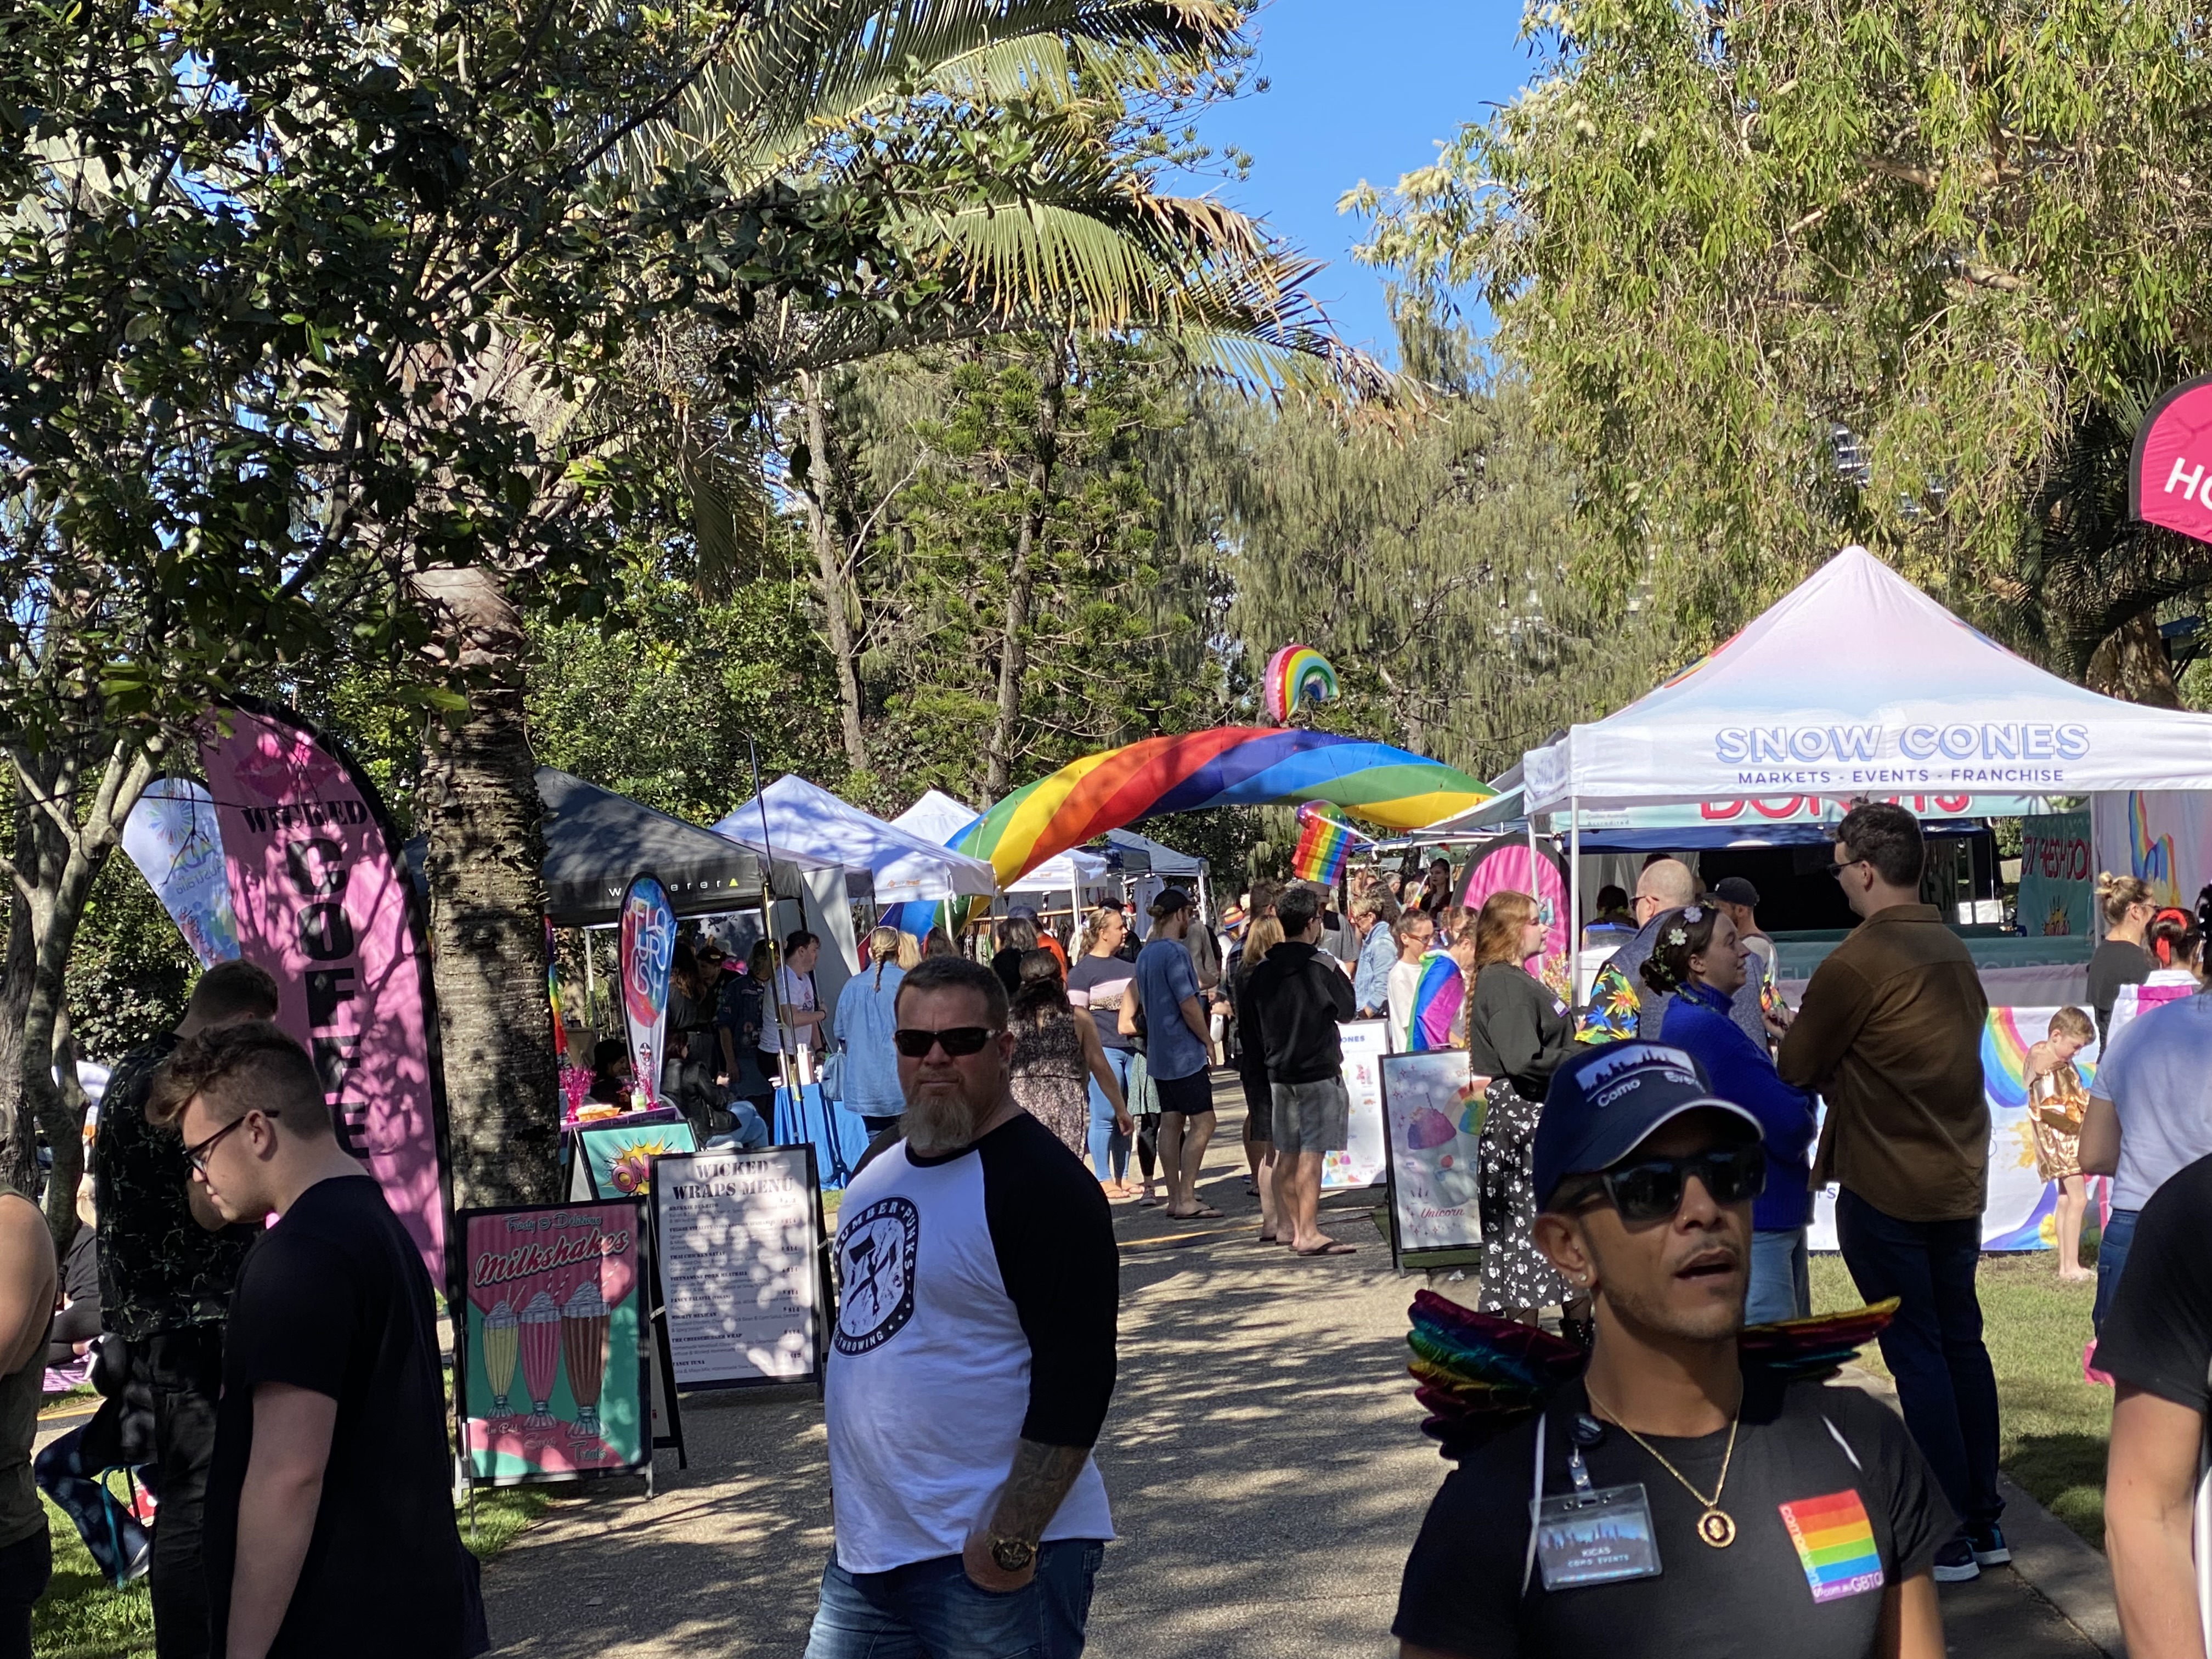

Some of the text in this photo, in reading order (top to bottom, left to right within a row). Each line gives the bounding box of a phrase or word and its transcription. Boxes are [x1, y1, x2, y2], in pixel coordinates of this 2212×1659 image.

[1716, 724, 2090, 763] SNOW CONES
[1739, 771, 1830, 783] MARKETS
[1853, 770, 1929, 782] EVENTS
[1951, 769, 2064, 782] FRANCHISE
[241, 800, 368, 833] WICKED
[608, 880, 721, 897] werer
[284, 838, 371, 1173] COFFE
[1597, 1079, 1641, 1108] Como
[696, 1160, 769, 1179] WICKED
[672, 1177, 793, 1200] WRAPS MENU
[503, 1215, 537, 1234] Frosty
[552, 1211, 602, 1229] Delicious
[1420, 1206, 1465, 1220] Unicorn
[834, 1201, 916, 1269] LUMBER PUNKS
[474, 1227, 629, 1288] Milkshakes
